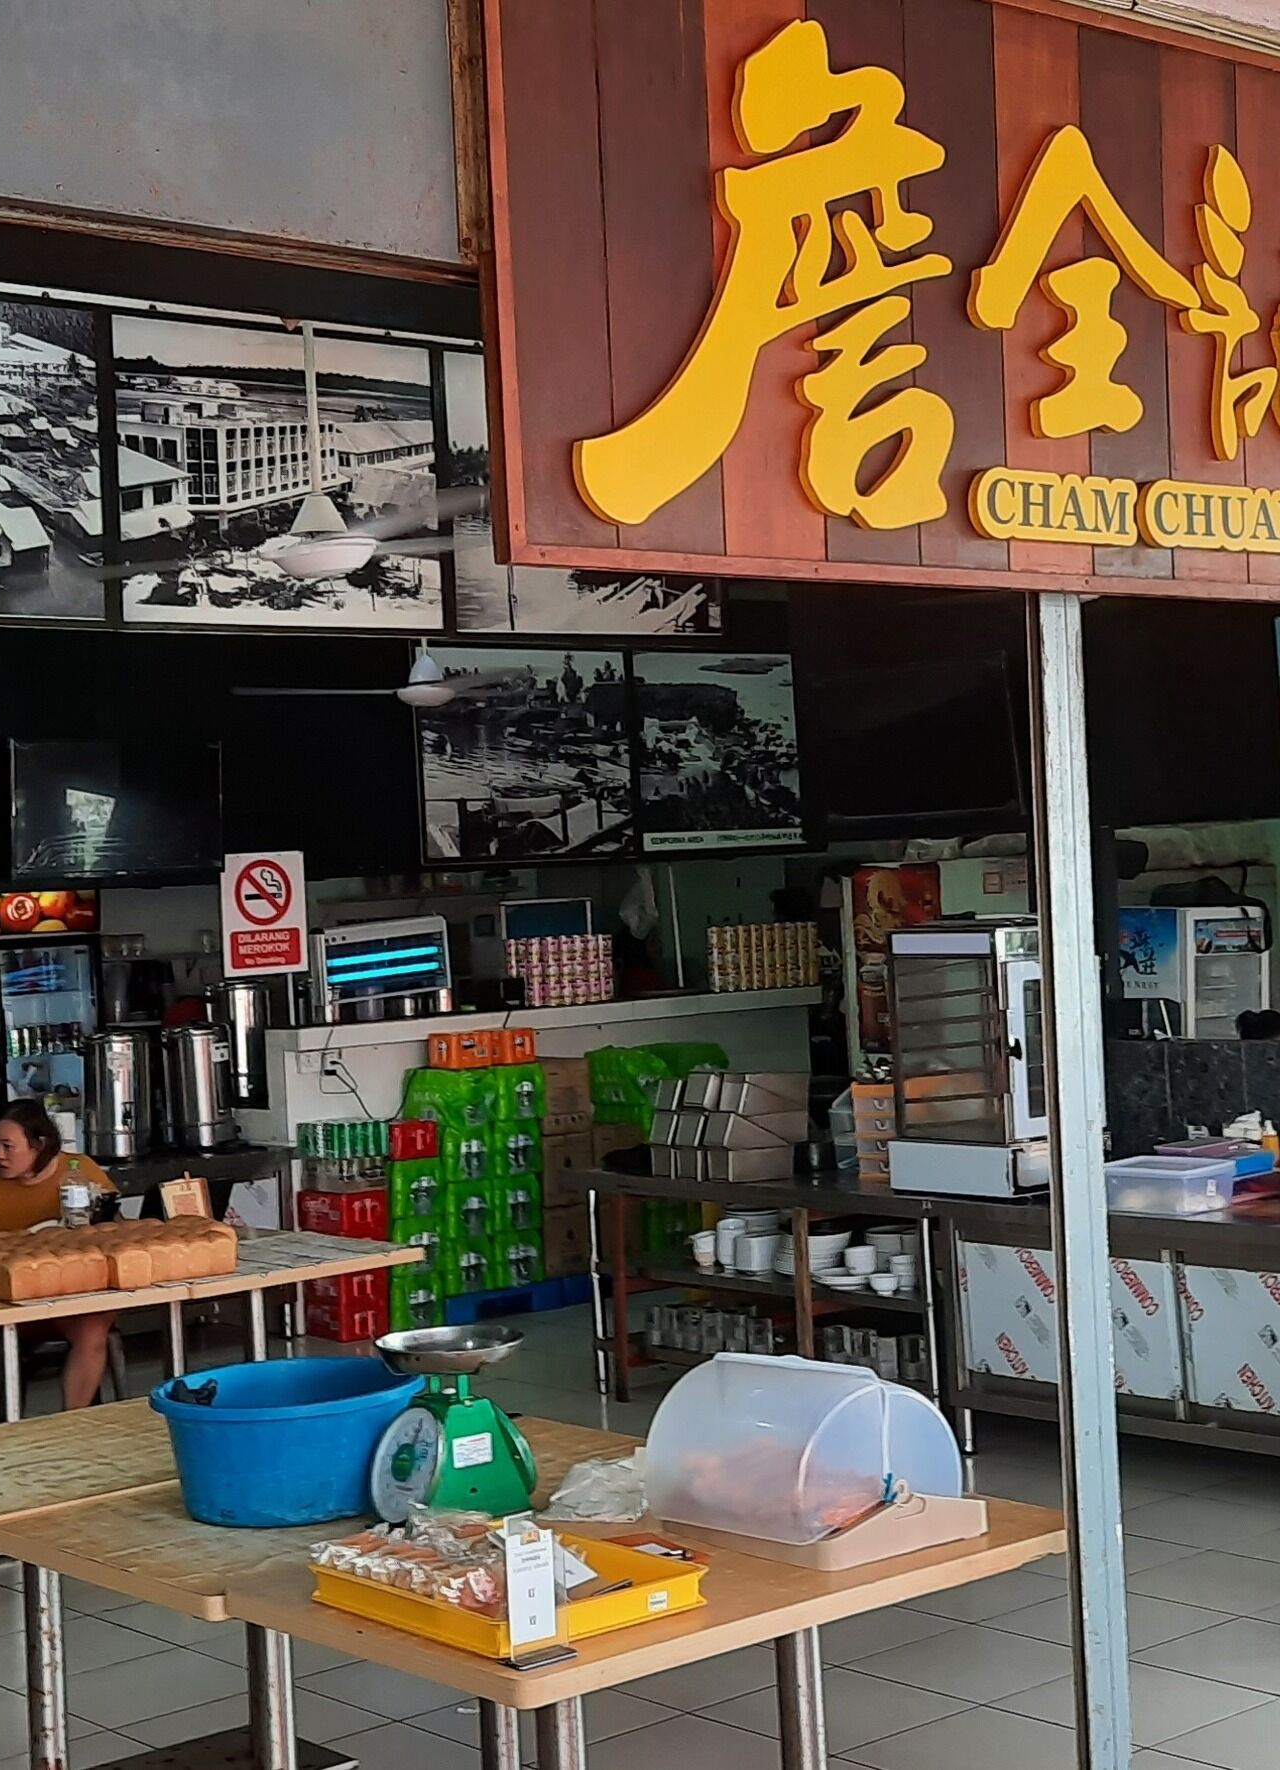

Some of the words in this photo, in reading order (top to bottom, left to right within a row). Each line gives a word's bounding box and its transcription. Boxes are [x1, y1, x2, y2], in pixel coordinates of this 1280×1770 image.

[987, 477, 1130, 536] CHAM
[237, 930, 290, 944] DILARANG
[238, 942, 291, 955] MEROKOK
